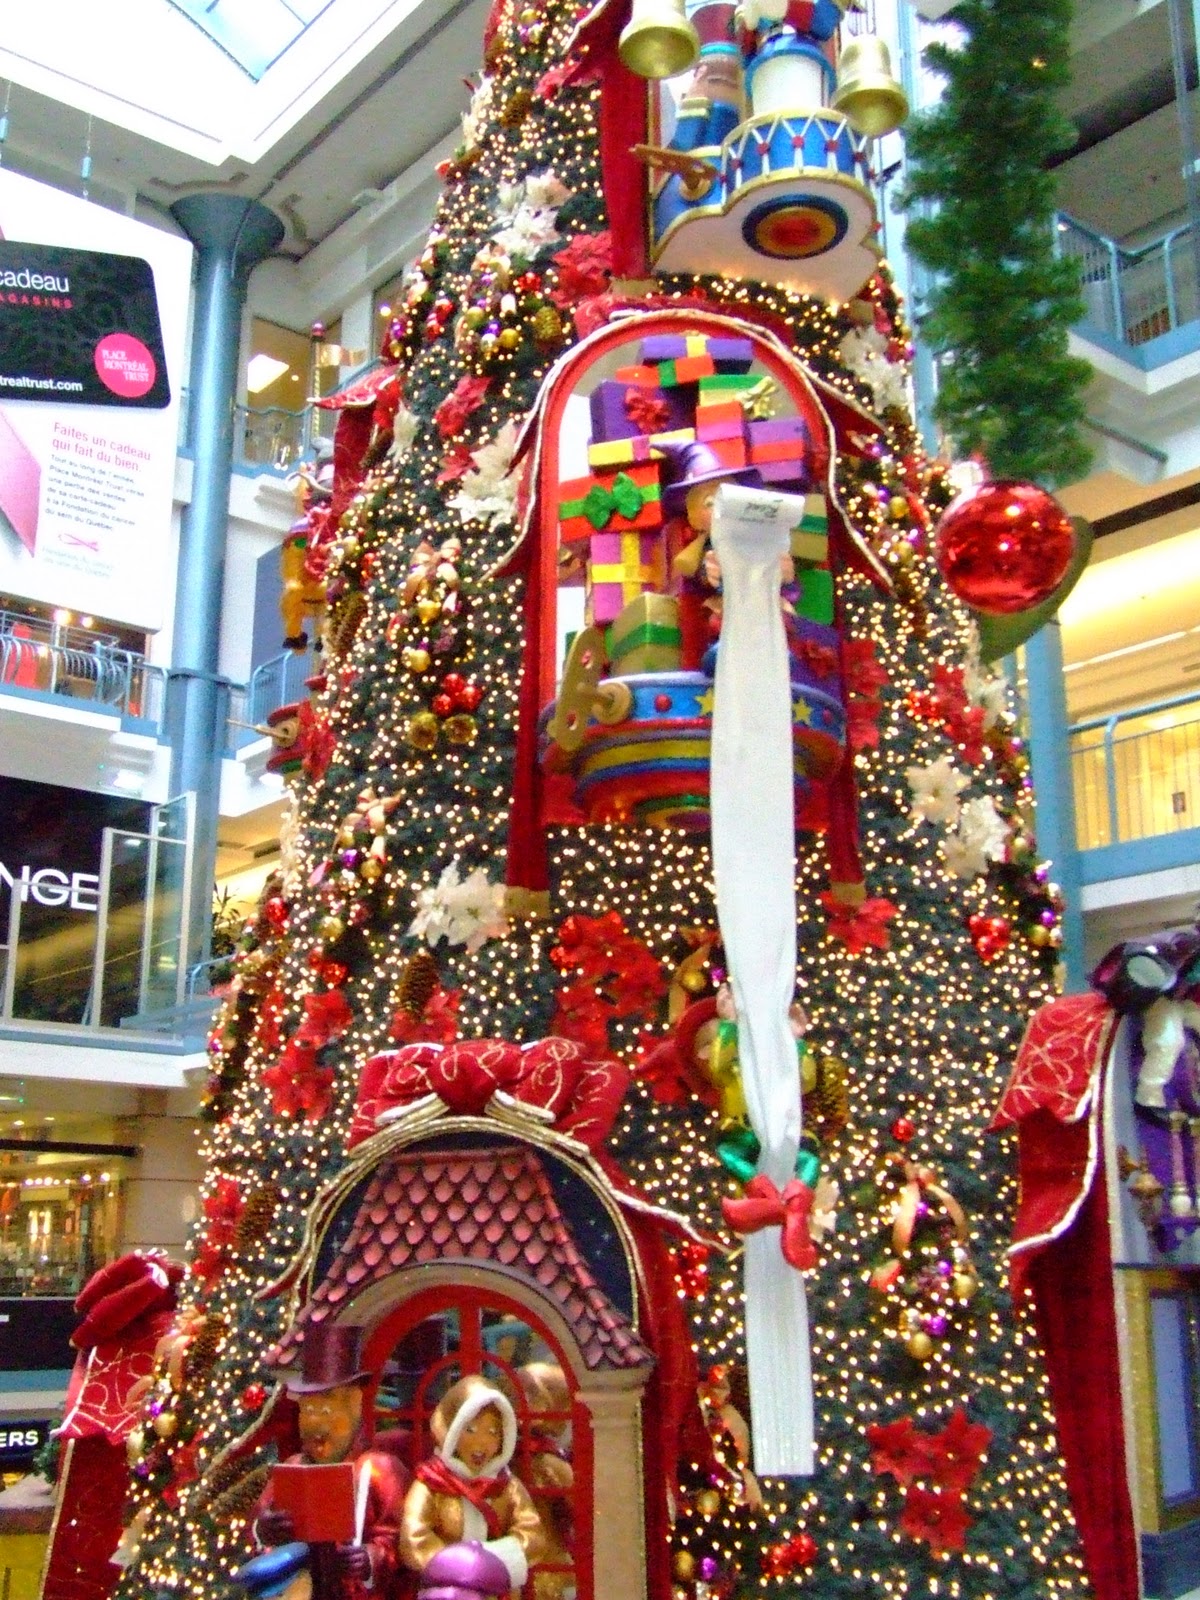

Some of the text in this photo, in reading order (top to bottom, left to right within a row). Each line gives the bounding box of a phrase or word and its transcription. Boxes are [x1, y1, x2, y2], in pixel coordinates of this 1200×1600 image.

[102, 350, 127, 360] PLACE
[123, 371, 149, 382] TRUST
[52, 438, 70, 451] qui
[75, 443, 93, 458] fait
[97, 451, 111, 463] du
[54, 422, 151, 461] Faites un cadeau
